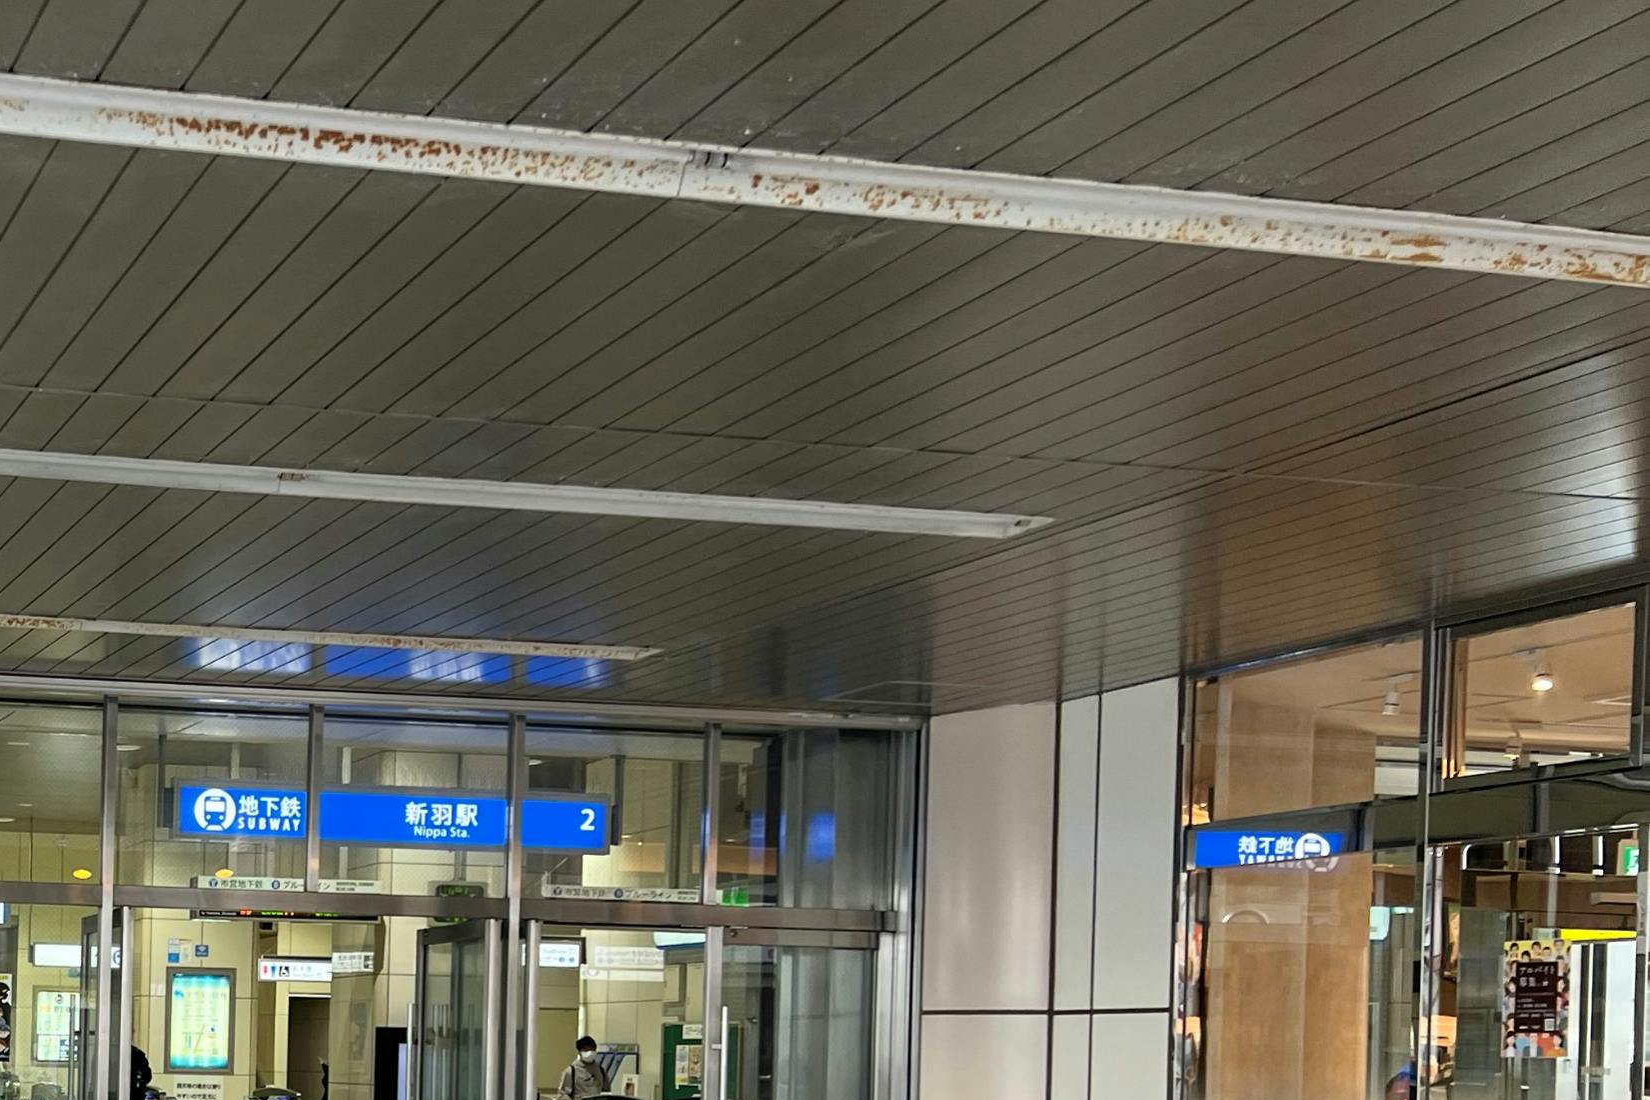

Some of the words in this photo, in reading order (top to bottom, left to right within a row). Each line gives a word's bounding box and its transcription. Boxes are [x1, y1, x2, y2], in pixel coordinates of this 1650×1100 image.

[238, 795, 301, 818] 地下鉄
[405, 801, 478, 827] 新羽駅
[237, 817, 301, 832] SUBWAY
[580, 808, 595, 831] 2
[414, 825, 447, 839] Nippa
[450, 827, 470, 838] Sta.
